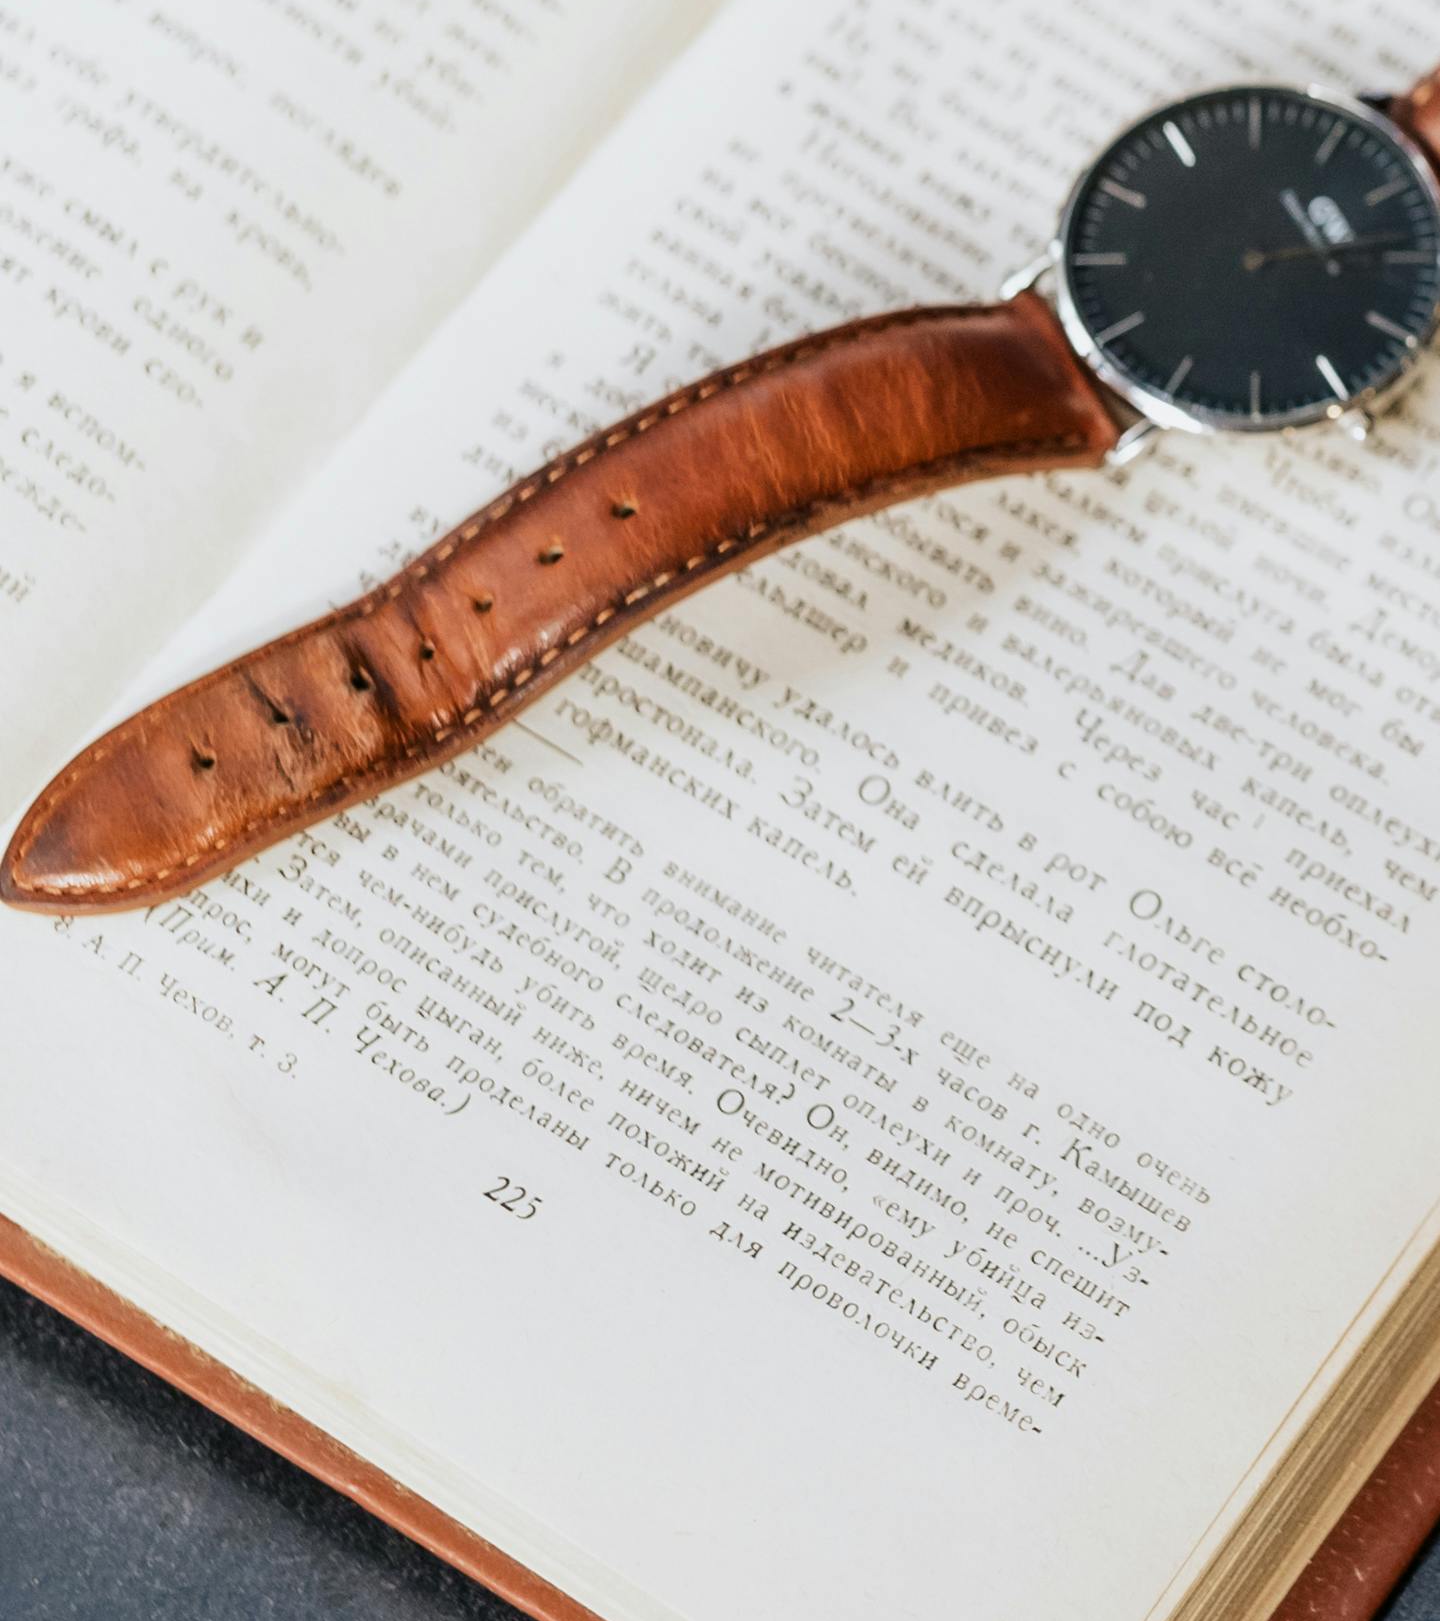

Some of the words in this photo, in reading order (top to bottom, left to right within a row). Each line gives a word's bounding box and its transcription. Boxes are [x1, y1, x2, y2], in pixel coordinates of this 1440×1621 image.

[80, 932, 105, 961] А.
[116, 950, 145, 983] П.
[247, 1032, 266, 1059] т.
[275, 1051, 299, 1079] 3.
[526, 776, 645, 858] обратить
[661, 860, 787, 944] внимание
[805, 945, 925, 1029] читателя
[938, 1030, 991, 1070] еще
[1005, 1070, 1040, 1100] на
[1055, 1102, 1122, 1149] одно
[1134, 1150, 1211, 1205] очень
[553, 697, 740, 821] гофманских
[745, 815, 857, 897] капель.
[616, 638, 820, 775] шампанского.
[856, 774, 920, 831] Она
[949, 840, 1074, 924] сделала
[1101, 929, 1313, 1068] глотательное
[772, 685, 900, 770] удалось
[913, 768, 1005, 833] влить
[1015, 831, 1038, 852] в
[1042, 852, 1107, 892] рот
[1127, 888, 1225, 965] Ольге
[1235, 963, 1336, 1029] столо-
[778, 775, 876, 854] Затем
[890, 854, 928, 886] ей
[942, 884, 1119, 1002] впрыснули
[1131, 999, 1193, 1049] под
[1205, 1043, 1293, 1107] кожу
[251, 972, 289, 1003] А.
[299, 986, 339, 1034] П.
[354, 1023, 472, 1116] Чехова.)
[271, 941, 351, 998] могут
[364, 1000, 430, 1053] быть
[444, 1054, 590, 1151] проделаны
[603, 1151, 697, 1217] только
[707, 1220, 764, 1260] для
[776, 1259, 939, 1371] проволочки
[950, 1371, 1043, 1435] време-
[276, 852, 362, 928] Затем,
[378, 928, 523, 1027] описанный
[531, 1025, 604, 1081] ниже,
[617, 1078, 701, 1136] ничем
[710, 1136, 744, 1162] не
[758, 1160, 985, 1320] мотивированный,
[1001, 1317, 1087, 1379] обыск
[281, 906, 303, 927] и
[310, 928, 408, 993] допрос
[414, 994, 503, 1062] цыган,
[520, 1057, 595, 1112] более
[606, 1110, 730, 1193] похожий
[736, 1192, 770, 1222] на
[780, 1219, 996, 1367] издевательство,
[1016, 1366, 1066, 1408] чем
[357, 868, 504, 973] чем-нибудь
[522, 975, 595, 1031] убить
[610, 1032, 693, 1096] время.
[714, 1087, 849, 1193] Очевидно,
[871, 1195, 936, 1239] «ему
[942, 1238, 1047, 1311] убийца
[1060, 1310, 1105, 1343] из-
[380, 843, 399, 862] в
[410, 862, 460, 902] нем
[471, 902, 604, 991] судебного
[614, 983, 796, 1106] следователя?
[804, 1102, 849, 1151] Он,
[864, 1146, 969, 1224] видимо,
[983, 1220, 1018, 1249] не
[1028, 1248, 1131, 1318] спешит
[411, 781, 503, 846] только
[517, 848, 565, 893] тем,
[587, 892, 631, 927] что
[641, 928, 723, 984] ходит
[733, 984, 769, 1014] из
[780, 1013, 898, 1094] комнаты
[910, 1094, 930, 1113] в
[942, 1113, 1059, 1198] комнату,
[1076, 1195, 1170, 1256] возму-
[481, 1175, 543, 1220] 225
[482, 868, 624, 970] прислугой,
[636, 965, 723, 1025] щедро
[733, 1025, 831, 1091] сыплет
[841, 1093, 952, 1167] оплеухи
[960, 1166, 983, 1187] и
[992, 1184, 1062, 1238] проч.
[1076, 1240, 1150, 1286] ...Уз-
[602, 854, 633, 885] В
[640, 887, 815, 1001] продолжение
[828, 996, 920, 1067] 2—3-х
[936, 1066, 1009, 1121] часов
[1020, 1122, 1041, 1146] г.
[1058, 1136, 1192, 1233] Камышев
